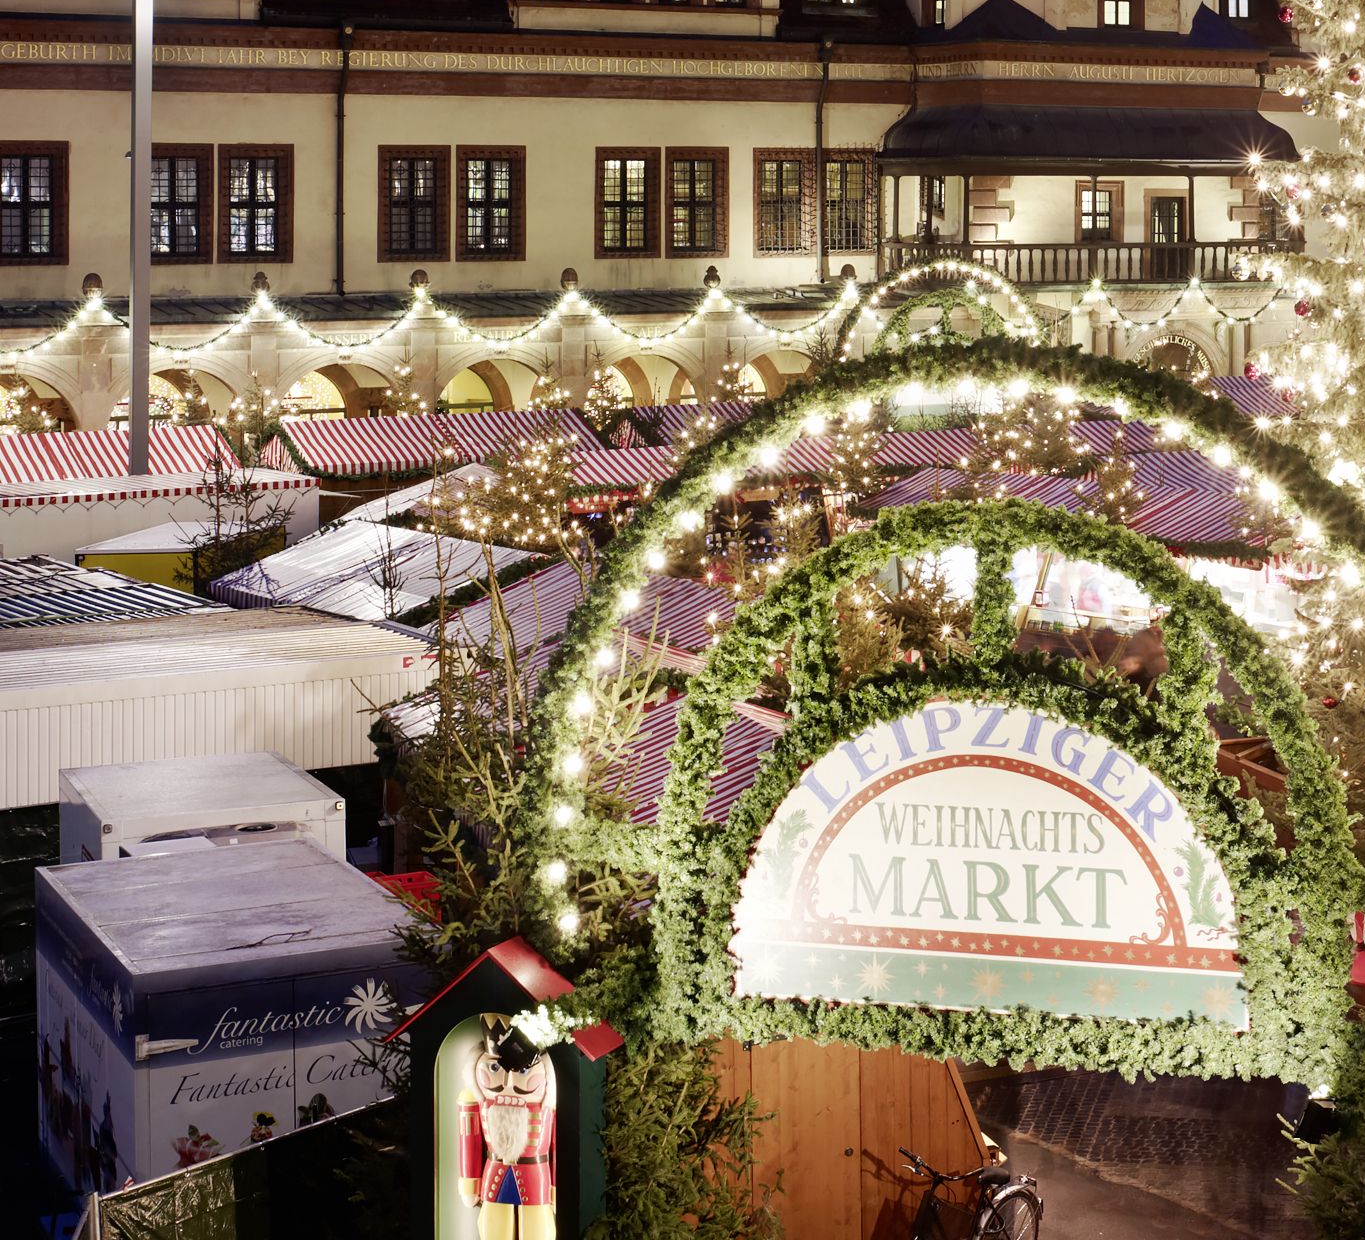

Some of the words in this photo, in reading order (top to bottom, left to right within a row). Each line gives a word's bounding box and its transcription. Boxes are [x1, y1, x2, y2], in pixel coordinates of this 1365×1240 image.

[801, 704, 1174, 842] LEIPZIGER
[875, 801, 1106, 855] WEIHNACHTS
[848, 853, 1128, 930] MARKT
[187, 1000, 345, 1055] fantastic
[219, 1035, 263, 1050] catering
[169, 1065, 296, 1105] Fantastic
